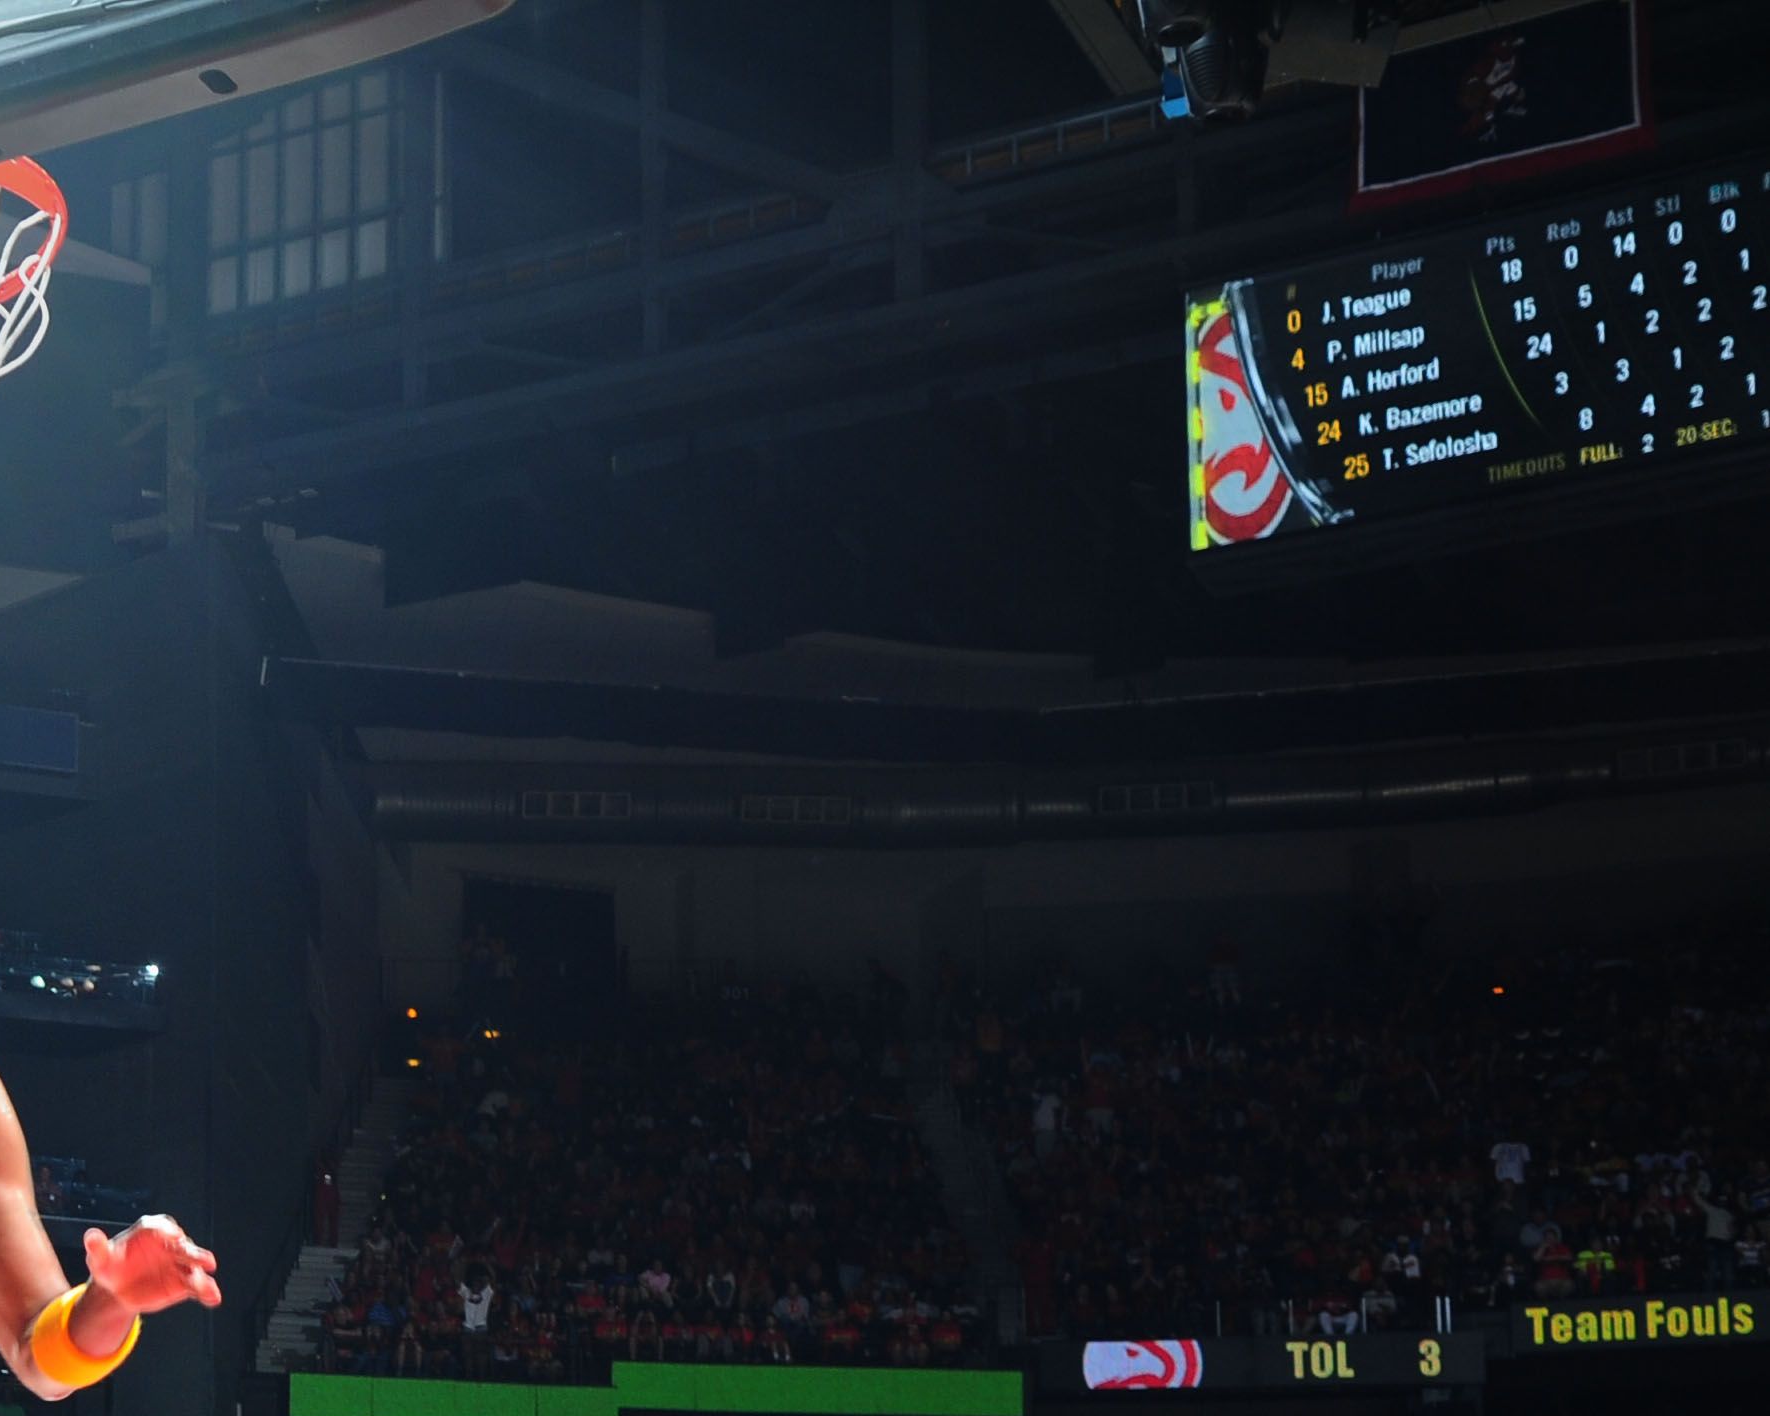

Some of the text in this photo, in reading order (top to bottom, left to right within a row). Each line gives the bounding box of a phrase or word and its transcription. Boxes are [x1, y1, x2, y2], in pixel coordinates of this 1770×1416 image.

[1287, 208, 1736, 334] 0 J. Teague 18 0 14 0 0
[1372, 257, 1424, 282] Player
[1486, 236, 1516, 256] Pts
[1546, 219, 1581, 242] Reb
[1605, 206, 1634, 228] Ast
[1291, 248, 1750, 370] 4 P. Millsap 15 5 4 2 1
[1305, 285, 1767, 407] 15 A. Horford 24 1 2 2 2
[1317, 335, 1735, 446] 24 K. Bazemore 3 3 1 2
[1343, 372, 1756, 480] 25 T. Sefolosha 8 4 2 1
[1488, 453, 1567, 483] TIMEOUTS
[1642, 433, 1654, 454] 2
[1286, 1339, 1442, 1379] TOL 3
[1525, 1297, 1754, 1345] Team Fouls
